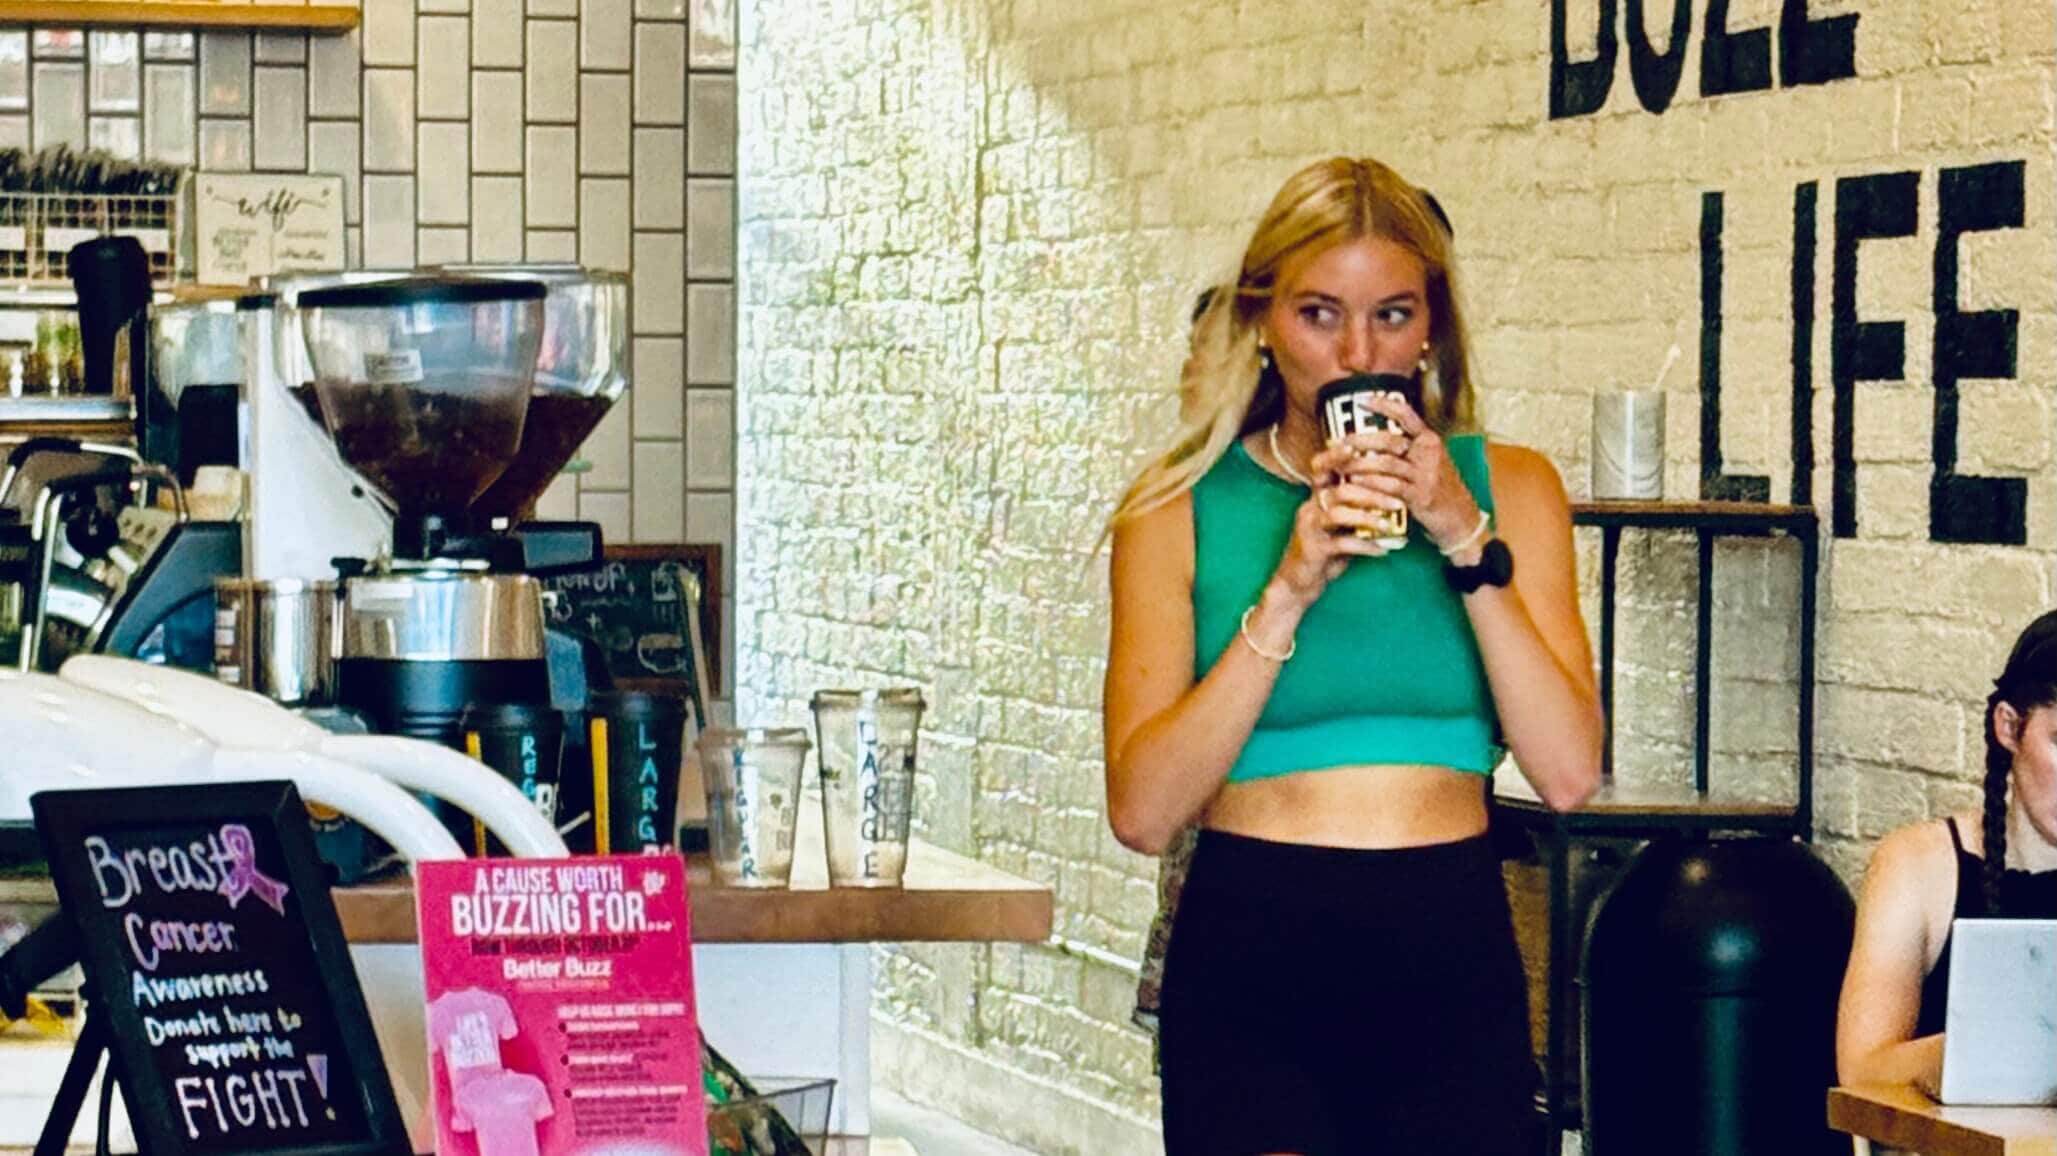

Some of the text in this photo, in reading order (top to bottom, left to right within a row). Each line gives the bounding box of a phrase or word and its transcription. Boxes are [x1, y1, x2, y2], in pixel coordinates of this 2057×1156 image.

[222, 187, 318, 232] wifi
[1699, 159, 2027, 544] LIFE
[638, 722, 658, 842] LARG
[858, 720, 879, 878] LARGE
[84, 833, 240, 908] Breast
[474, 864, 623, 895] A CAUSE WORTH
[451, 891, 673, 936] BUZZING FOR...
[124, 912, 235, 971] Cancer
[132, 968, 269, 1008] Awareness
[503, 955, 612, 980] Better Buzz
[144, 1004, 302, 1046] Donate here to
[185, 1035, 295, 1070] support the
[174, 1053, 336, 1140] FIGHT!
